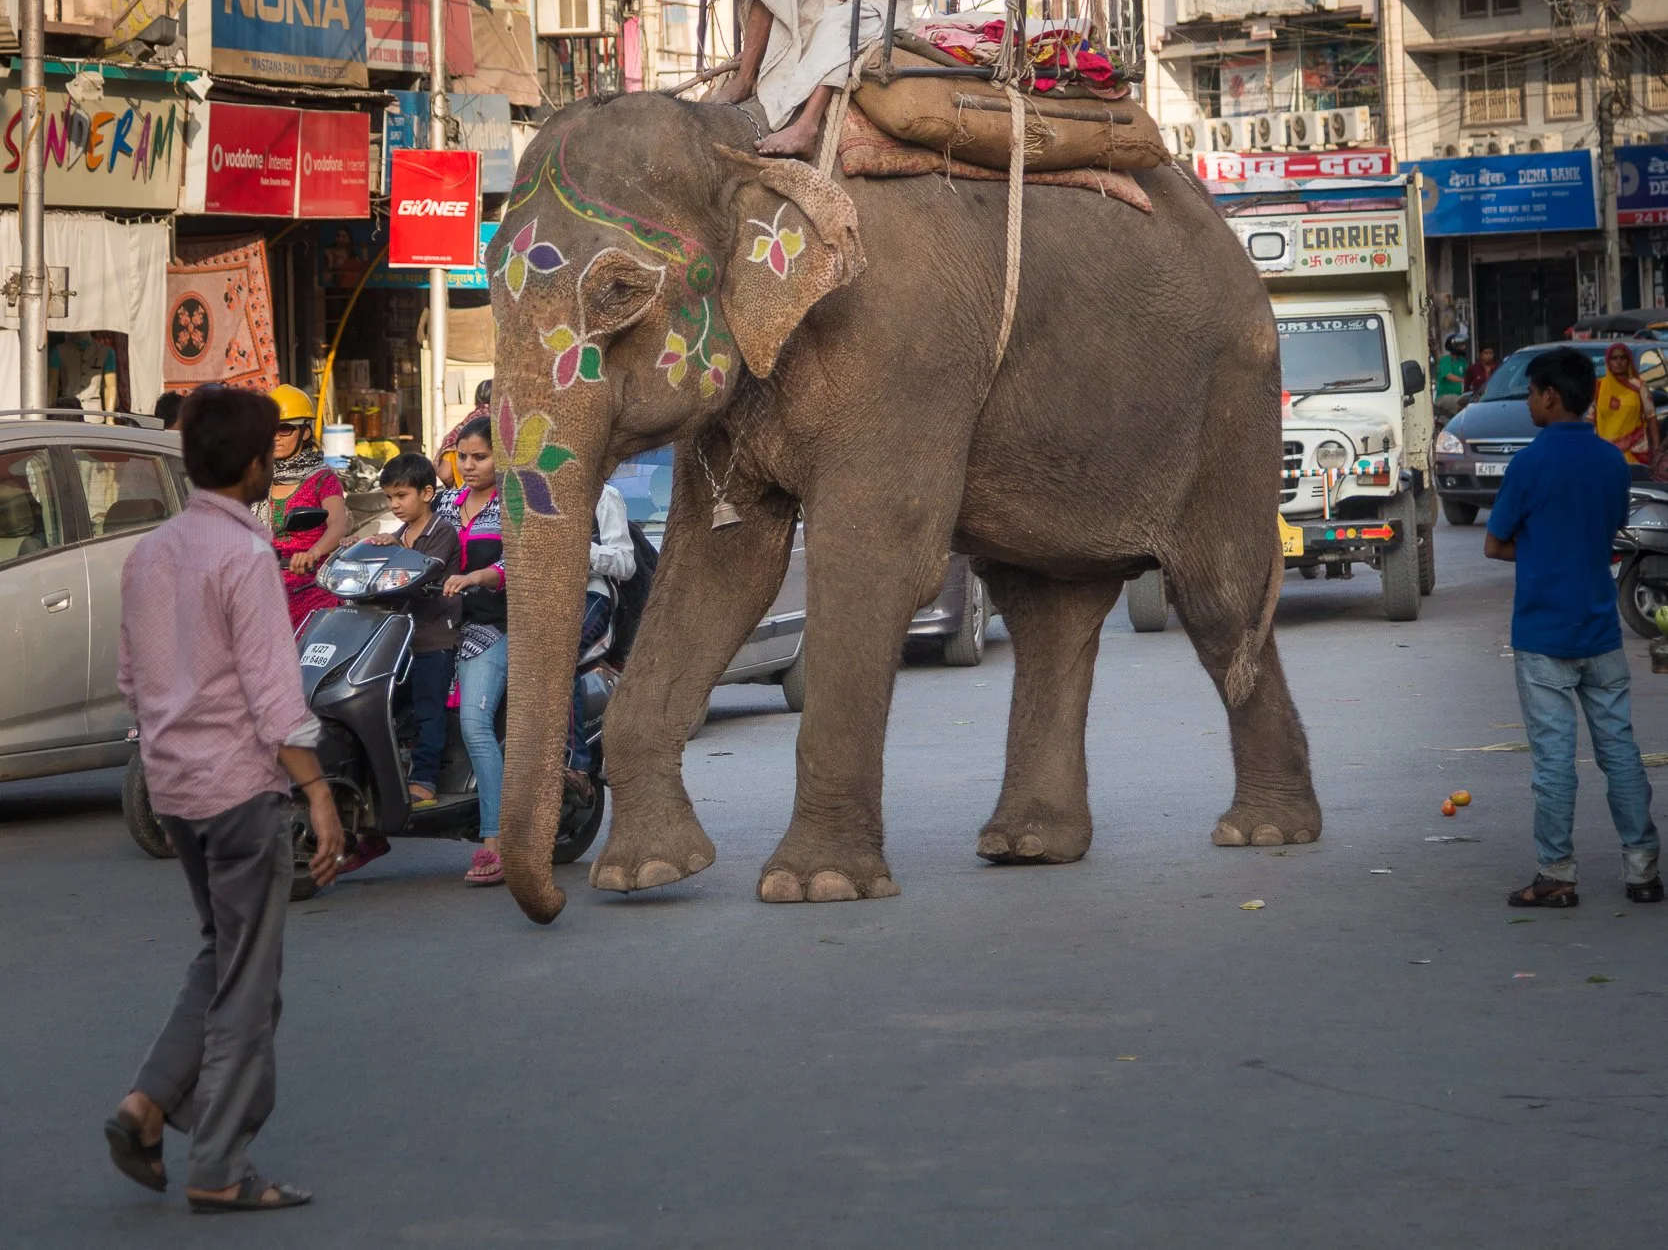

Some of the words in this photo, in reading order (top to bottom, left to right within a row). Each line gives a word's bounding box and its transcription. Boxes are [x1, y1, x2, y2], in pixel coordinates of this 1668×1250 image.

[4, 97, 176, 185] SNDERAM
[225, 148, 263, 169] vodafone
[268, 153, 293, 171] Internet
[313, 154, 343, 171] vodafone
[1518, 168, 1549, 184] DENA
[1551, 166, 1581, 183] BANK
[1634, 212, 1654, 224] 24
[1302, 223, 1400, 250] CARRIER
[1335, 253, 1359, 267] लाभ
[1311, 319, 1347, 329] LTD.
[310, 644, 330, 654] RJ27
[309, 655, 328, 666] 6489
